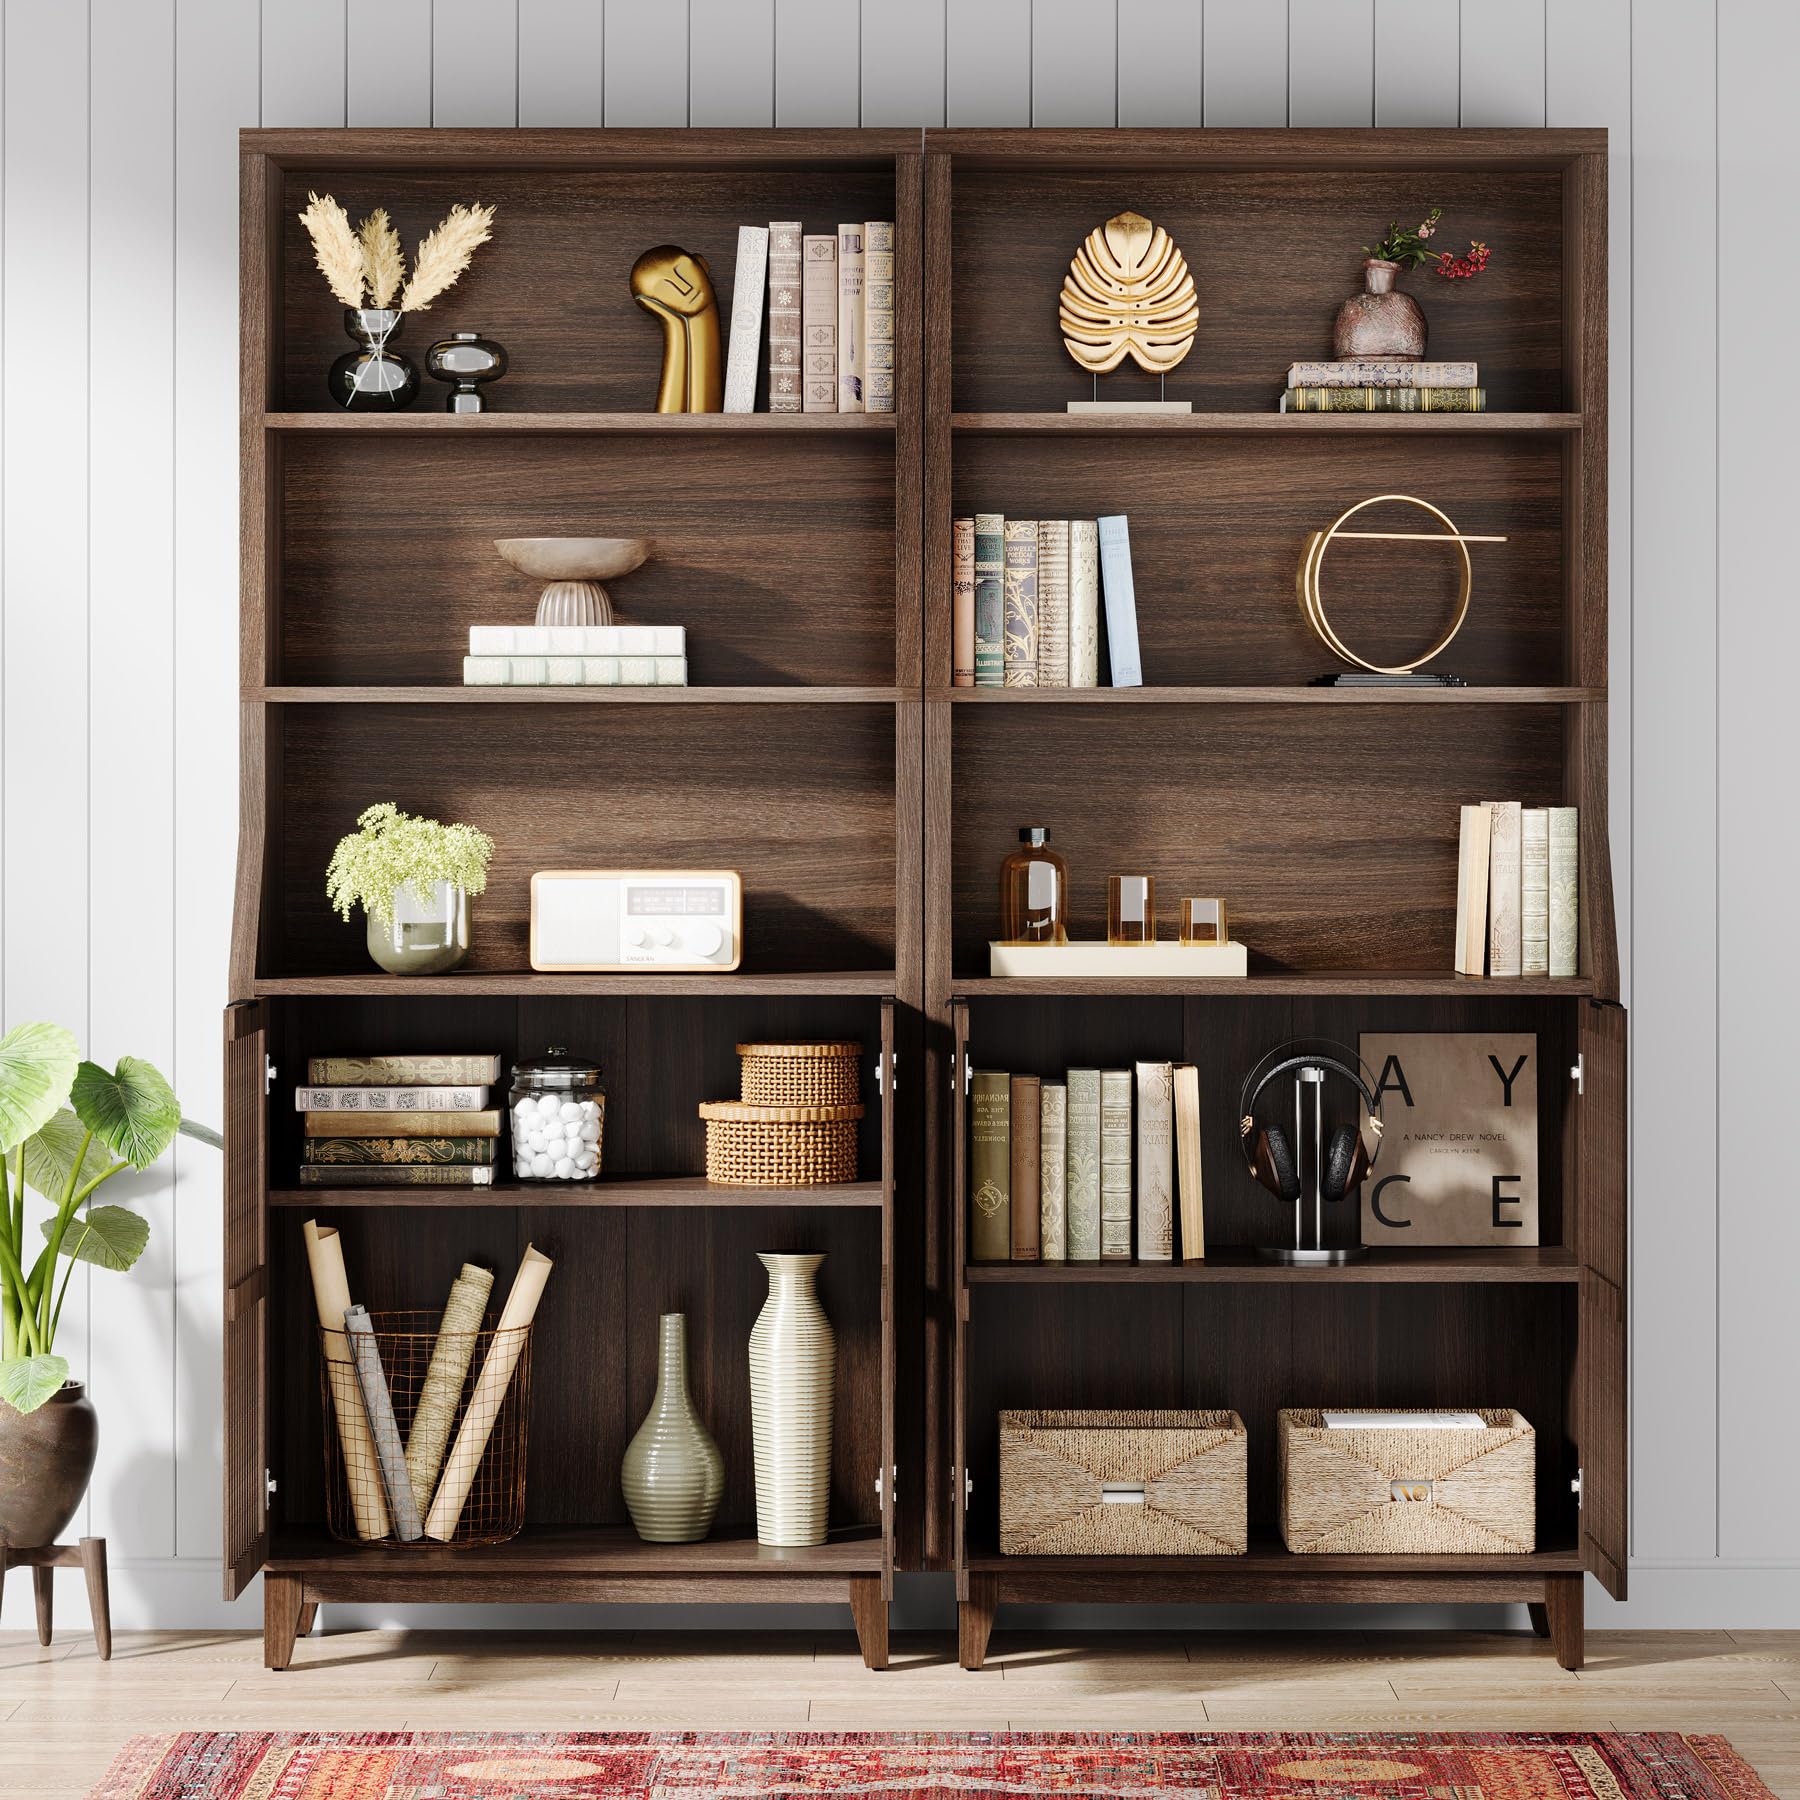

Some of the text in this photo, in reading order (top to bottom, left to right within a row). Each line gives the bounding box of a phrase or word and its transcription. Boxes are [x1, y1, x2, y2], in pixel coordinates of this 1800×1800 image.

[1372, 1054, 1529, 1107] A Y
[1403, 1133, 1507, 1141] A NANCY DREW NOVEL
[1370, 1174, 1523, 1228] C E
